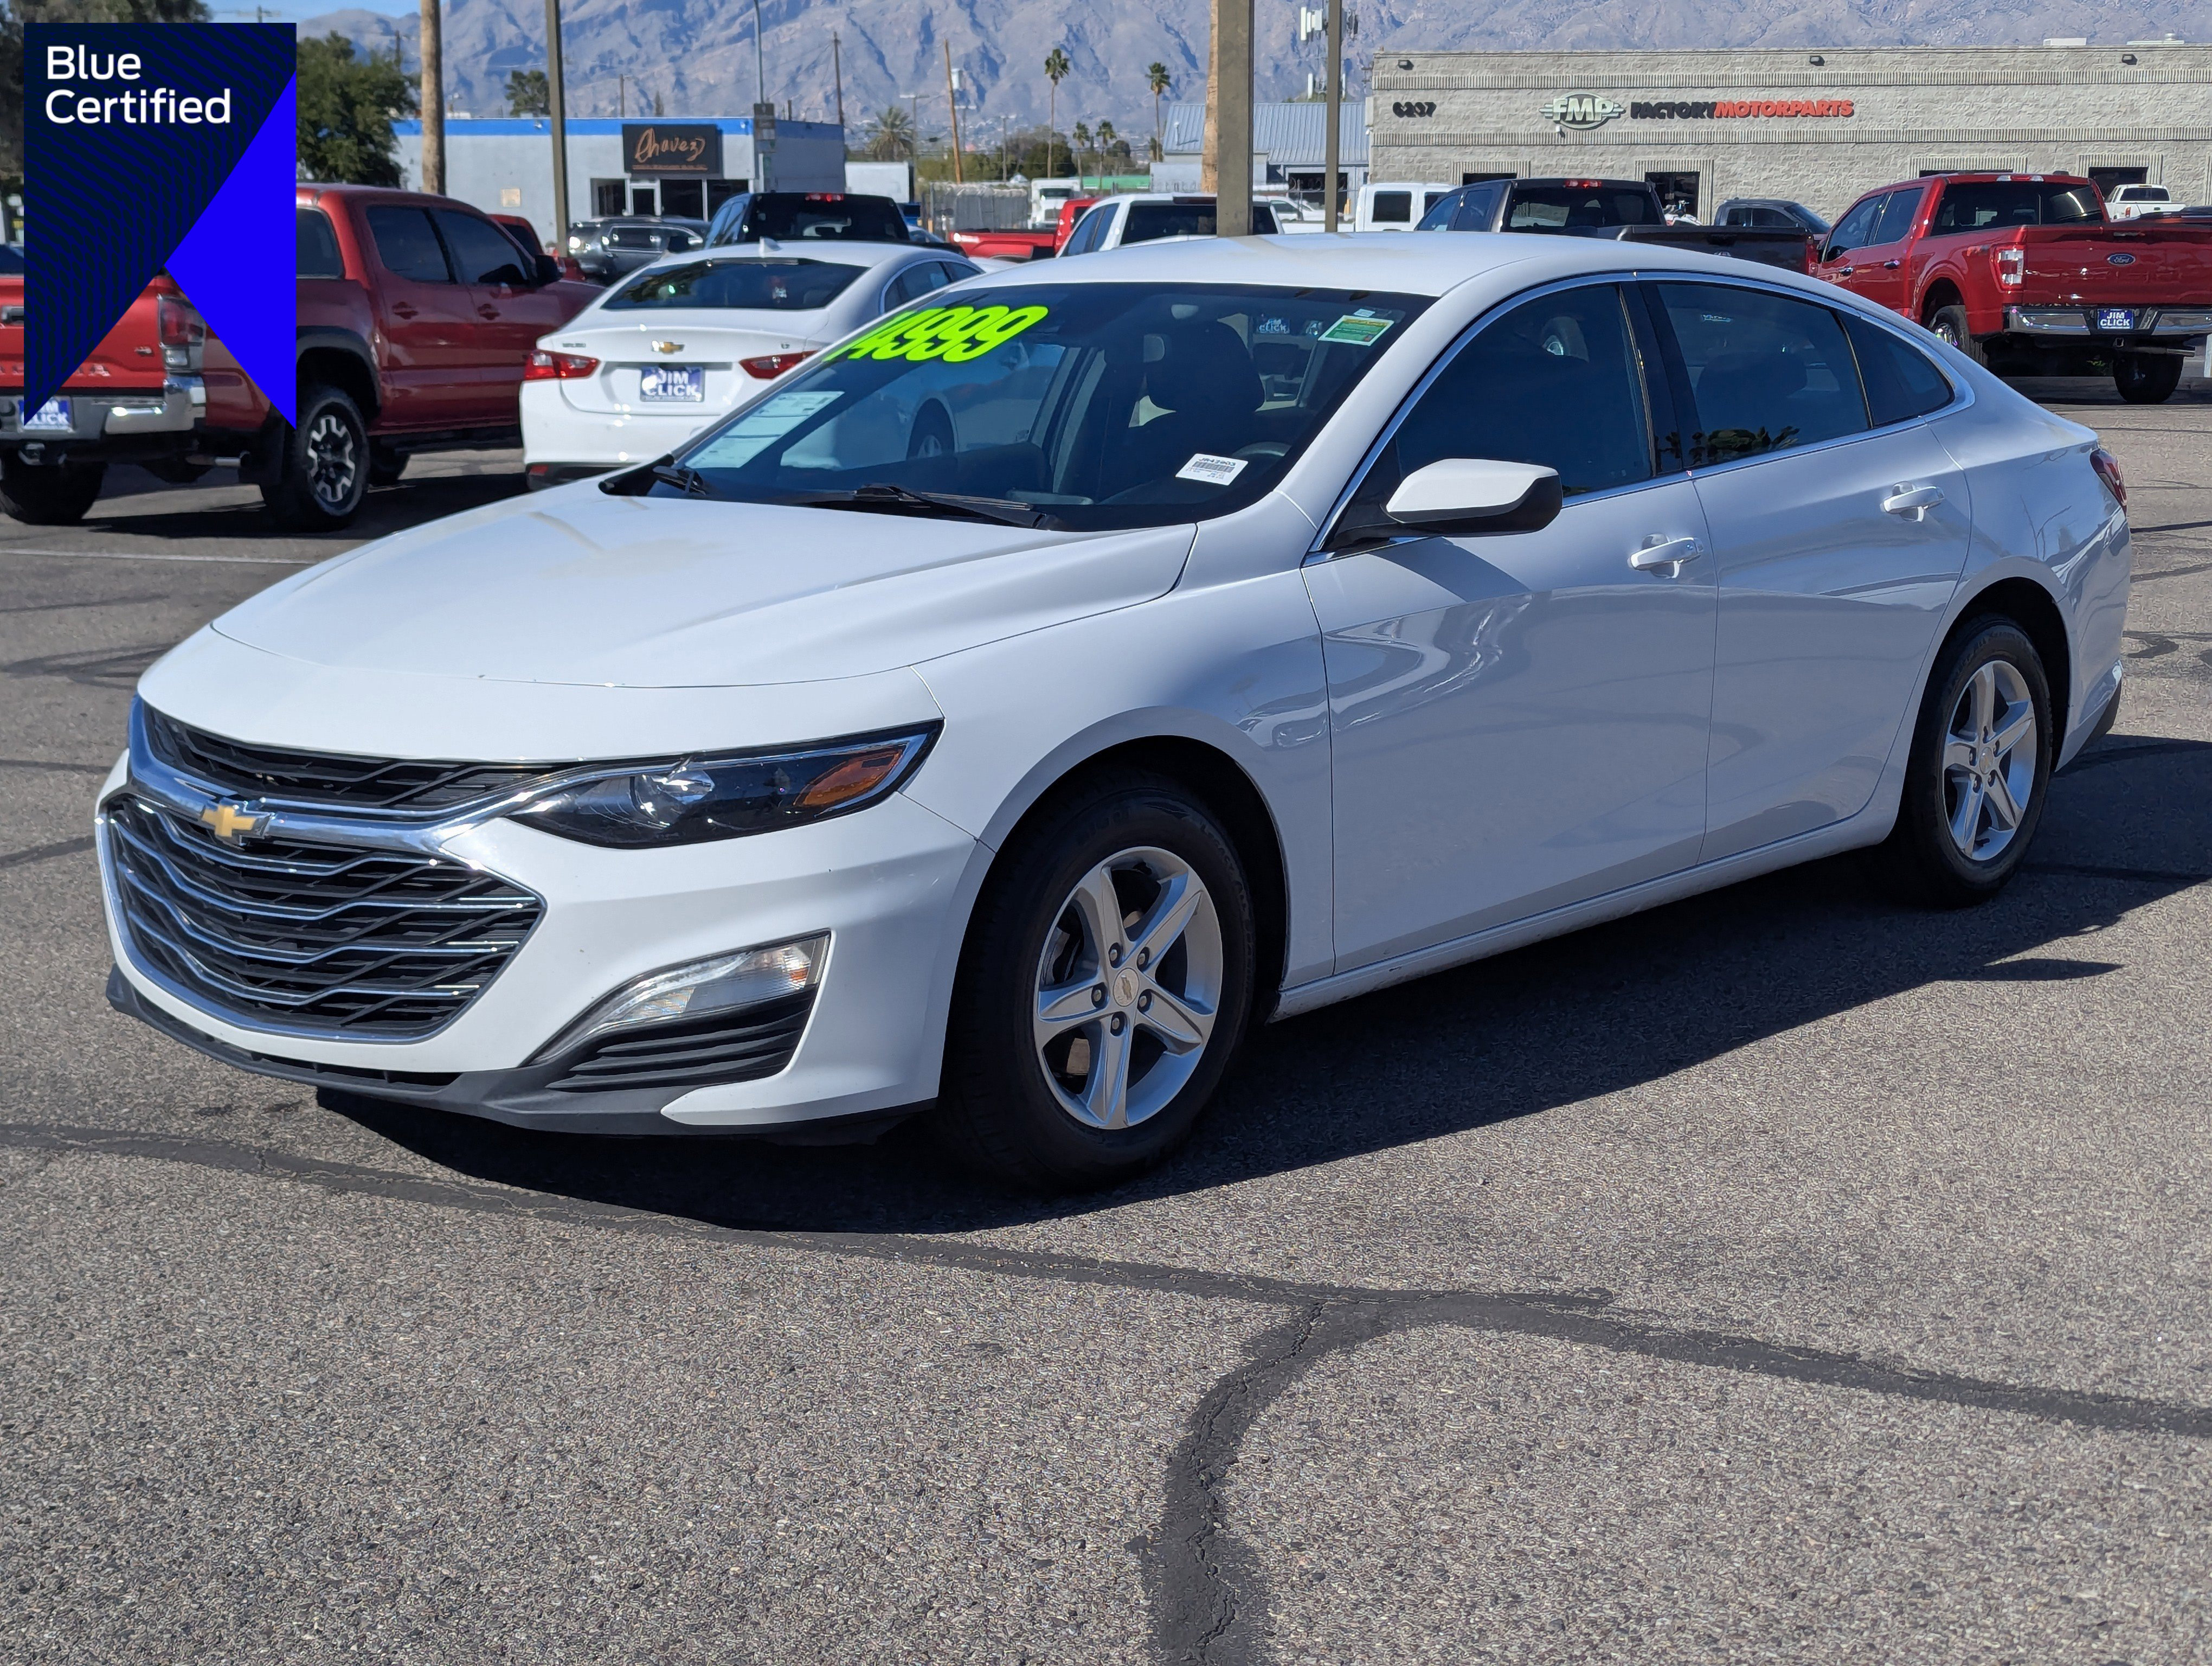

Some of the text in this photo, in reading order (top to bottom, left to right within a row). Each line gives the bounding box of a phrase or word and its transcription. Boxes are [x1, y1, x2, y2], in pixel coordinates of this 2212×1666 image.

[1553, 98, 1613, 121] FMP
[634, 127, 705, 163] Chavez
[657, 370, 689, 384] JIM
